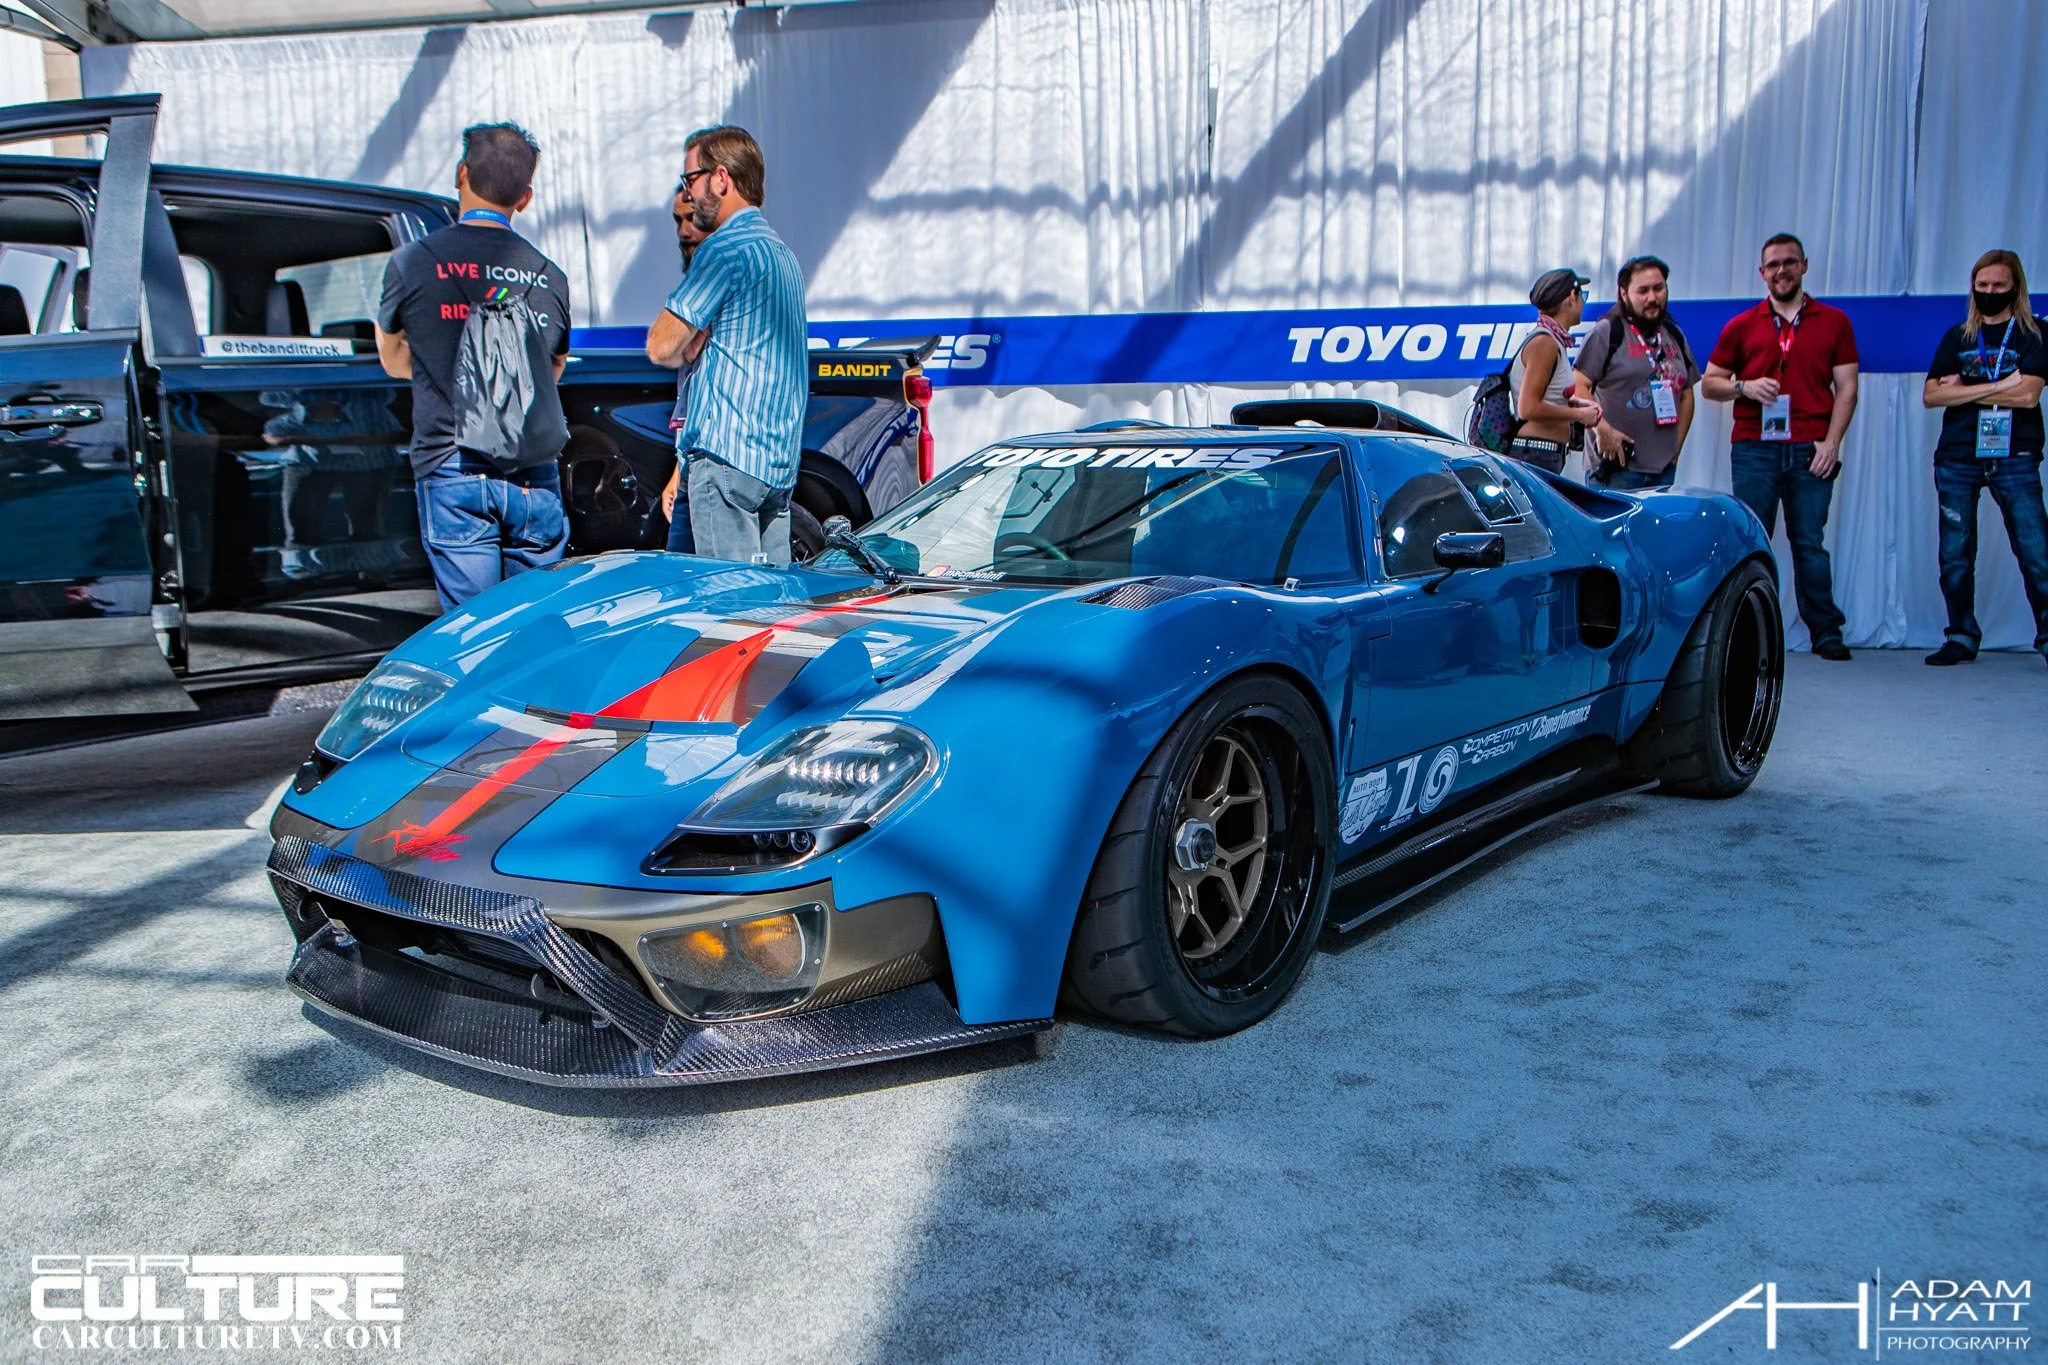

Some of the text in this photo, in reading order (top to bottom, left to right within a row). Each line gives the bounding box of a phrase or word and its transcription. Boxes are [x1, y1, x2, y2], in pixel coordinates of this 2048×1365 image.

[436, 263, 549, 289] LIVE ICONIC
[440, 303, 471, 320] RID
[221, 340, 340, 357] @thebandittruck
[1288, 324, 1448, 363] TOYO
[818, 364, 892, 377] BANDIT
[1537, 704, 1591, 739] Superformance
[1462, 720, 1533, 754] COMPETITION
[1472, 739, 1518, 765] CARBON
[1352, 776, 1385, 794] AUTO BODY
